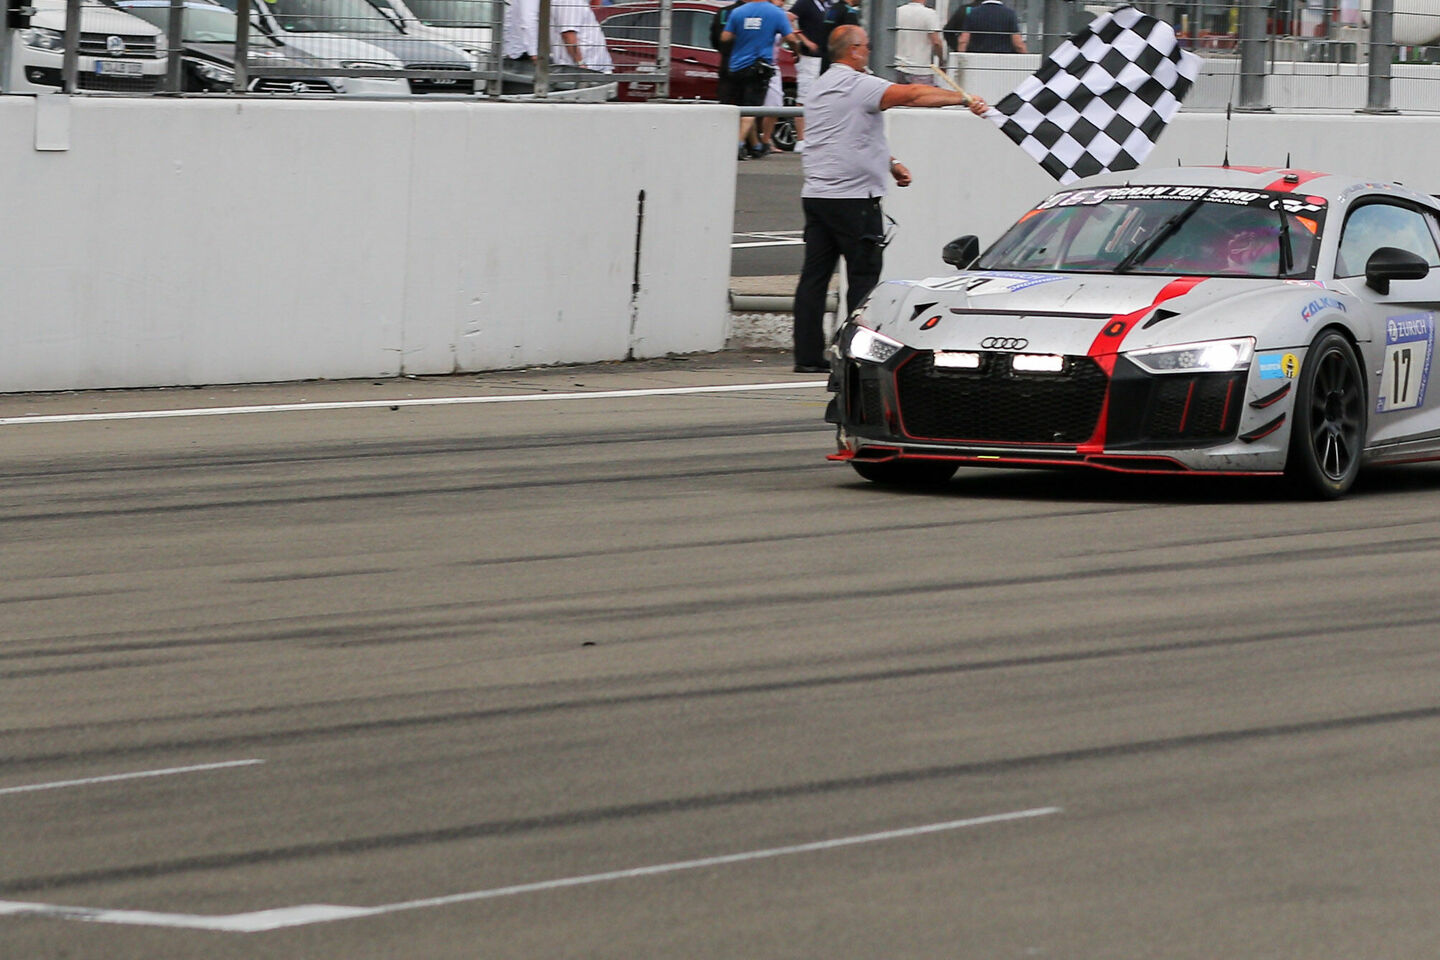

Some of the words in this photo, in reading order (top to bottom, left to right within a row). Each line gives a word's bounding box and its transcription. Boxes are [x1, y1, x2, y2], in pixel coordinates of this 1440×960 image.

[1111, 187, 1171, 196] GRAN
[1168, 187, 1260, 201] TURSMO
[1193, 196, 1249, 206] SMULATOR
[1398, 319, 1428, 339] ZURICH
[1393, 348, 1411, 405] 17
